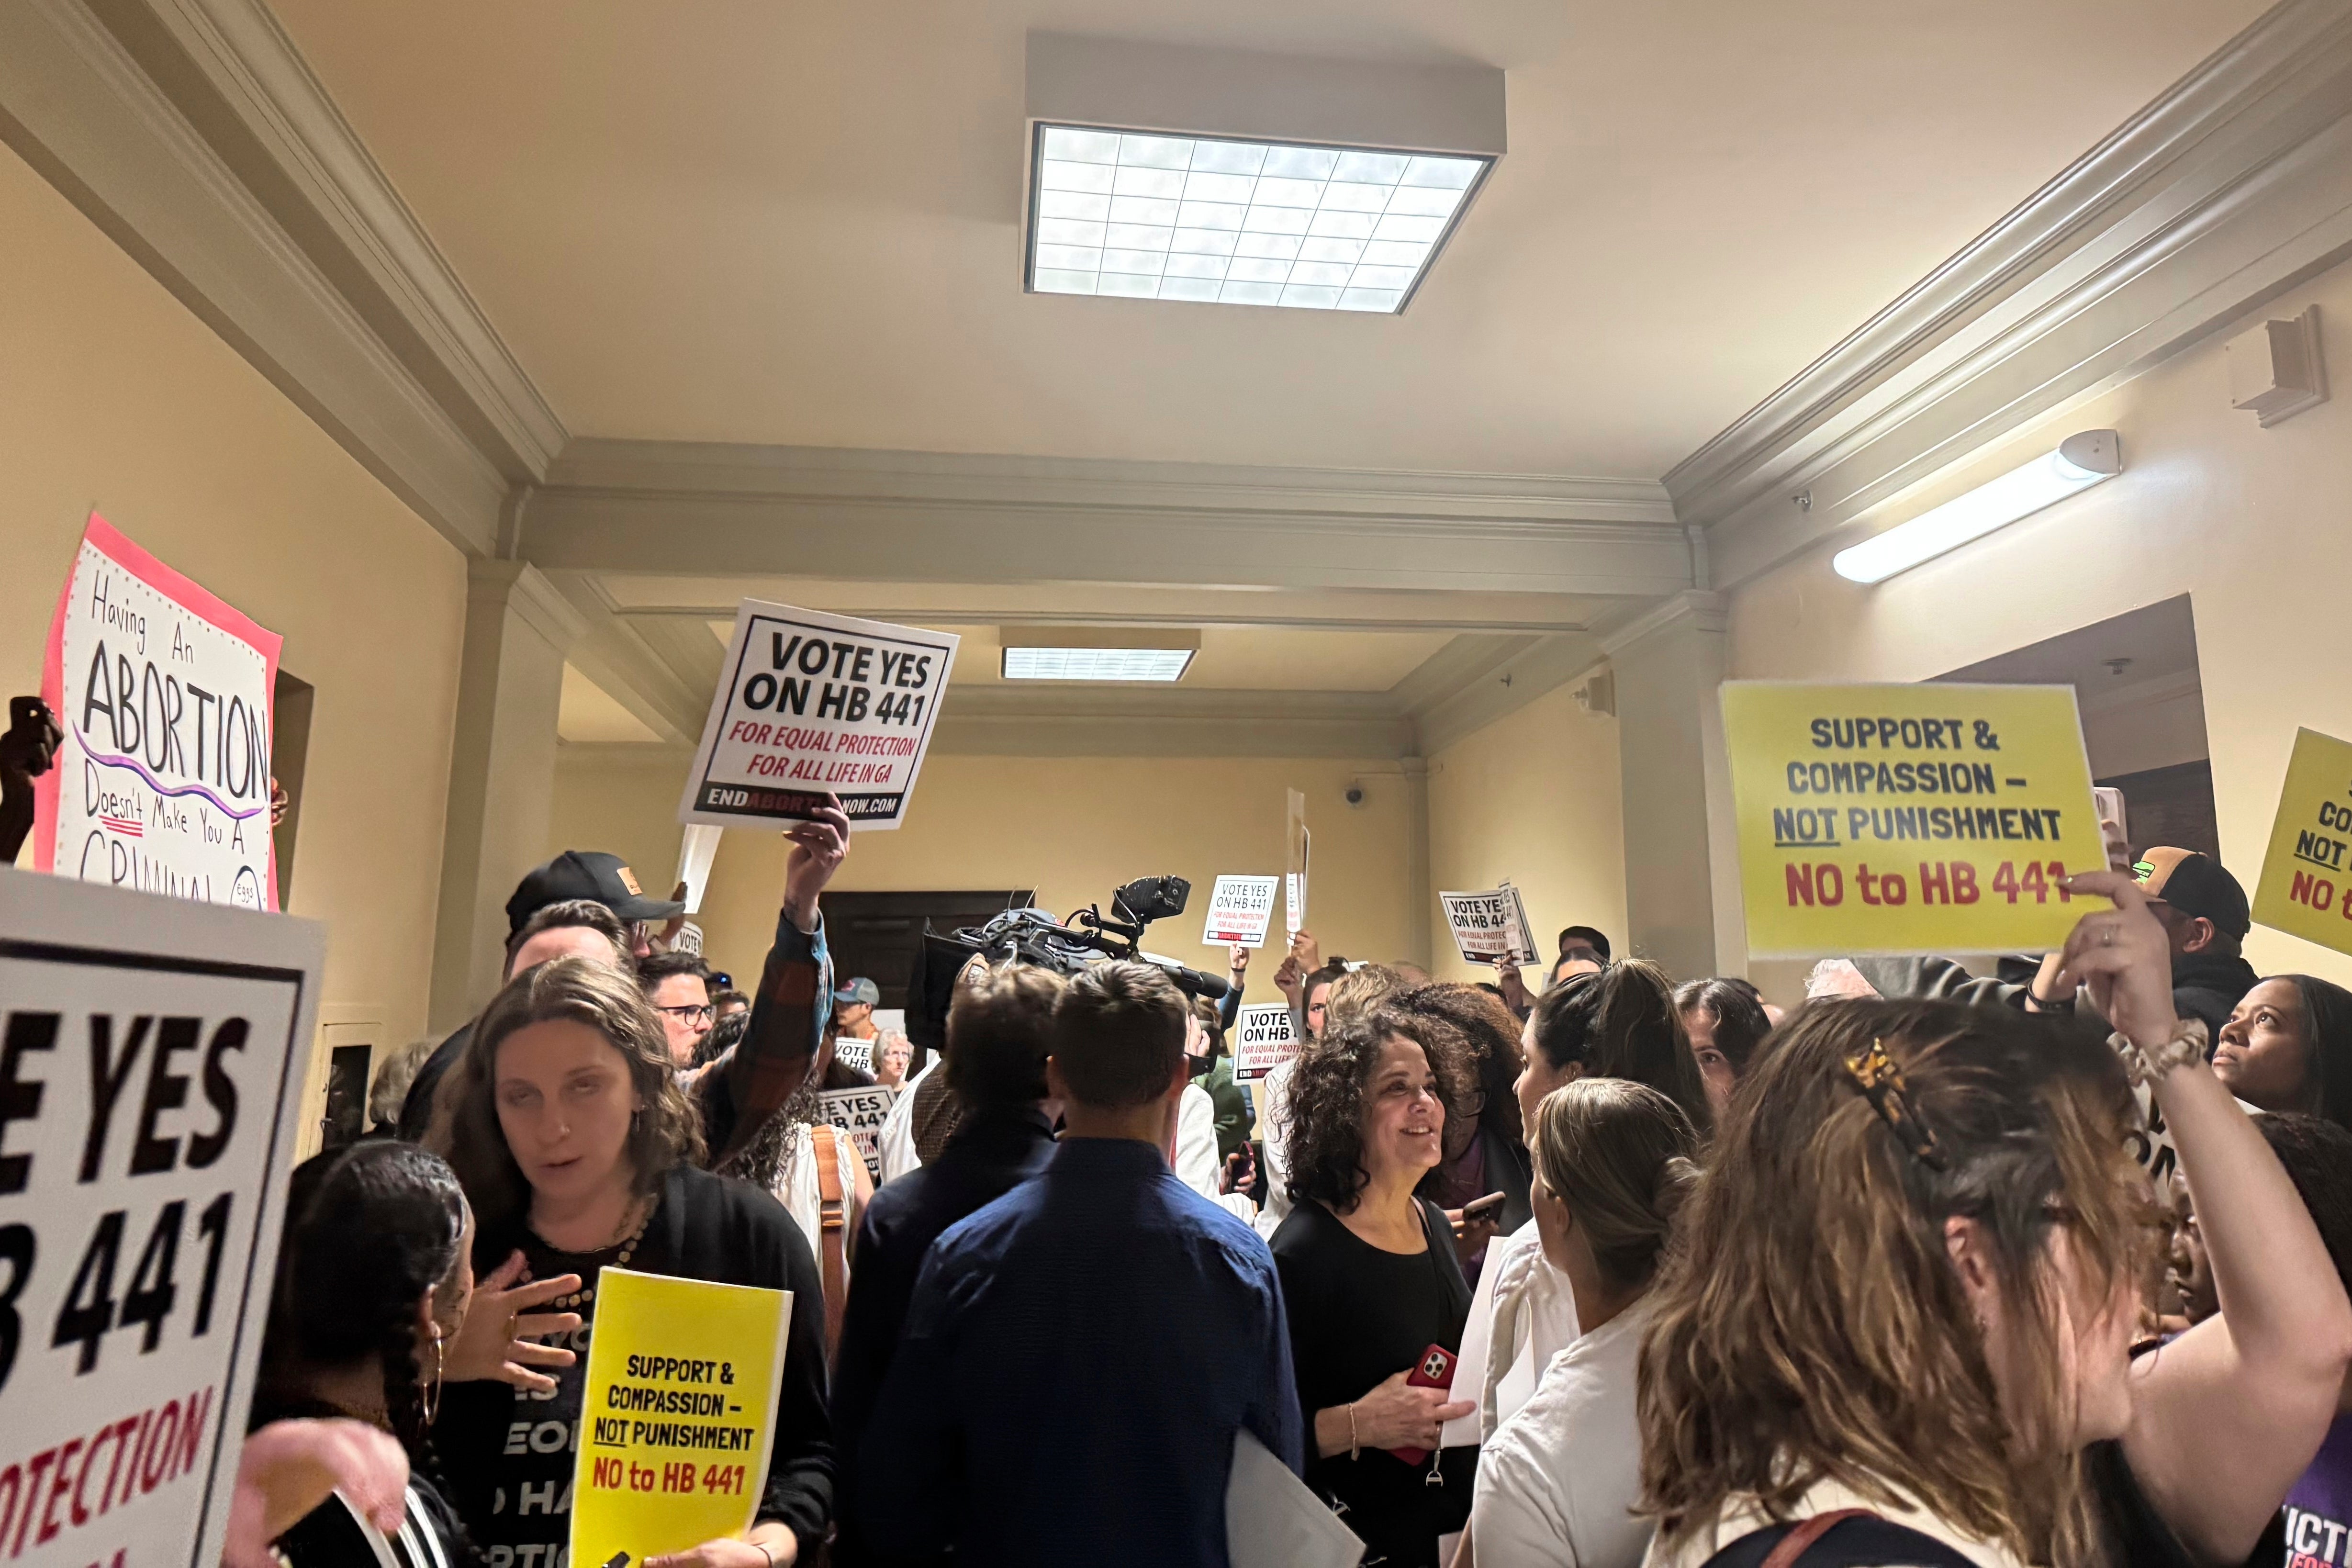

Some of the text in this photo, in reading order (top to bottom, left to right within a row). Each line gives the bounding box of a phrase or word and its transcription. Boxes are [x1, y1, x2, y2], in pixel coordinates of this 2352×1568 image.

[92, 570, 193, 664] Having An
[773, 632, 931, 689] VOTE YES
[743, 672, 925, 727] ON HB 441
[82, 639, 269, 801] ABORTION
[1810, 717, 2000, 751] SUPPORT &
[728, 720, 917, 757] FOR EQUAL PROTECTION
[747, 753, 893, 783] FOR ALL LIFE IN GA
[1787, 762, 1996, 795] COMPASSION
[86, 758, 244, 854] Doesn't Make You A
[707, 788, 897, 814] ENDABORTNOW.COM
[1773, 806, 2061, 841] NOT PUNISHMENT
[2296, 829, 2347, 866] NOT
[1223, 884, 1267, 896] VOTE YES
[1785, 861, 2071, 907] NO to HB 441
[2289, 870, 2334, 911] NO
[1217, 896, 1266, 910] ON HB 441
[1450, 900, 1482, 914] VOTE
[1453, 915, 1470, 928] ON
[1471, 915, 1489, 928] HB
[1483, 930, 1506, 940] PROTEC
[1244, 1027, 1289, 1042] ON HB
[1250, 1013, 1288, 1027] VOTE
[850, 1057, 869, 1069] HB
[1242, 1046, 1254, 1054] FOR
[1255, 1044, 1275, 1053] EQUAL
[1249, 1056, 1262, 1064] FOR
[1262, 1055, 1273, 1064] ALL
[77, 1014, 252, 1185] YES
[840, 1096, 881, 1114] YES
[50, 1191, 234, 1378] 441
[627, 1355, 735, 1384] SUPPORT &
[607, 1384, 725, 1417] COMPASSION
[594, 1417, 630, 1443] NOT
[632, 1421, 754, 1451] PUNISHMENT
[593, 1457, 746, 1495] NO to HB 441
